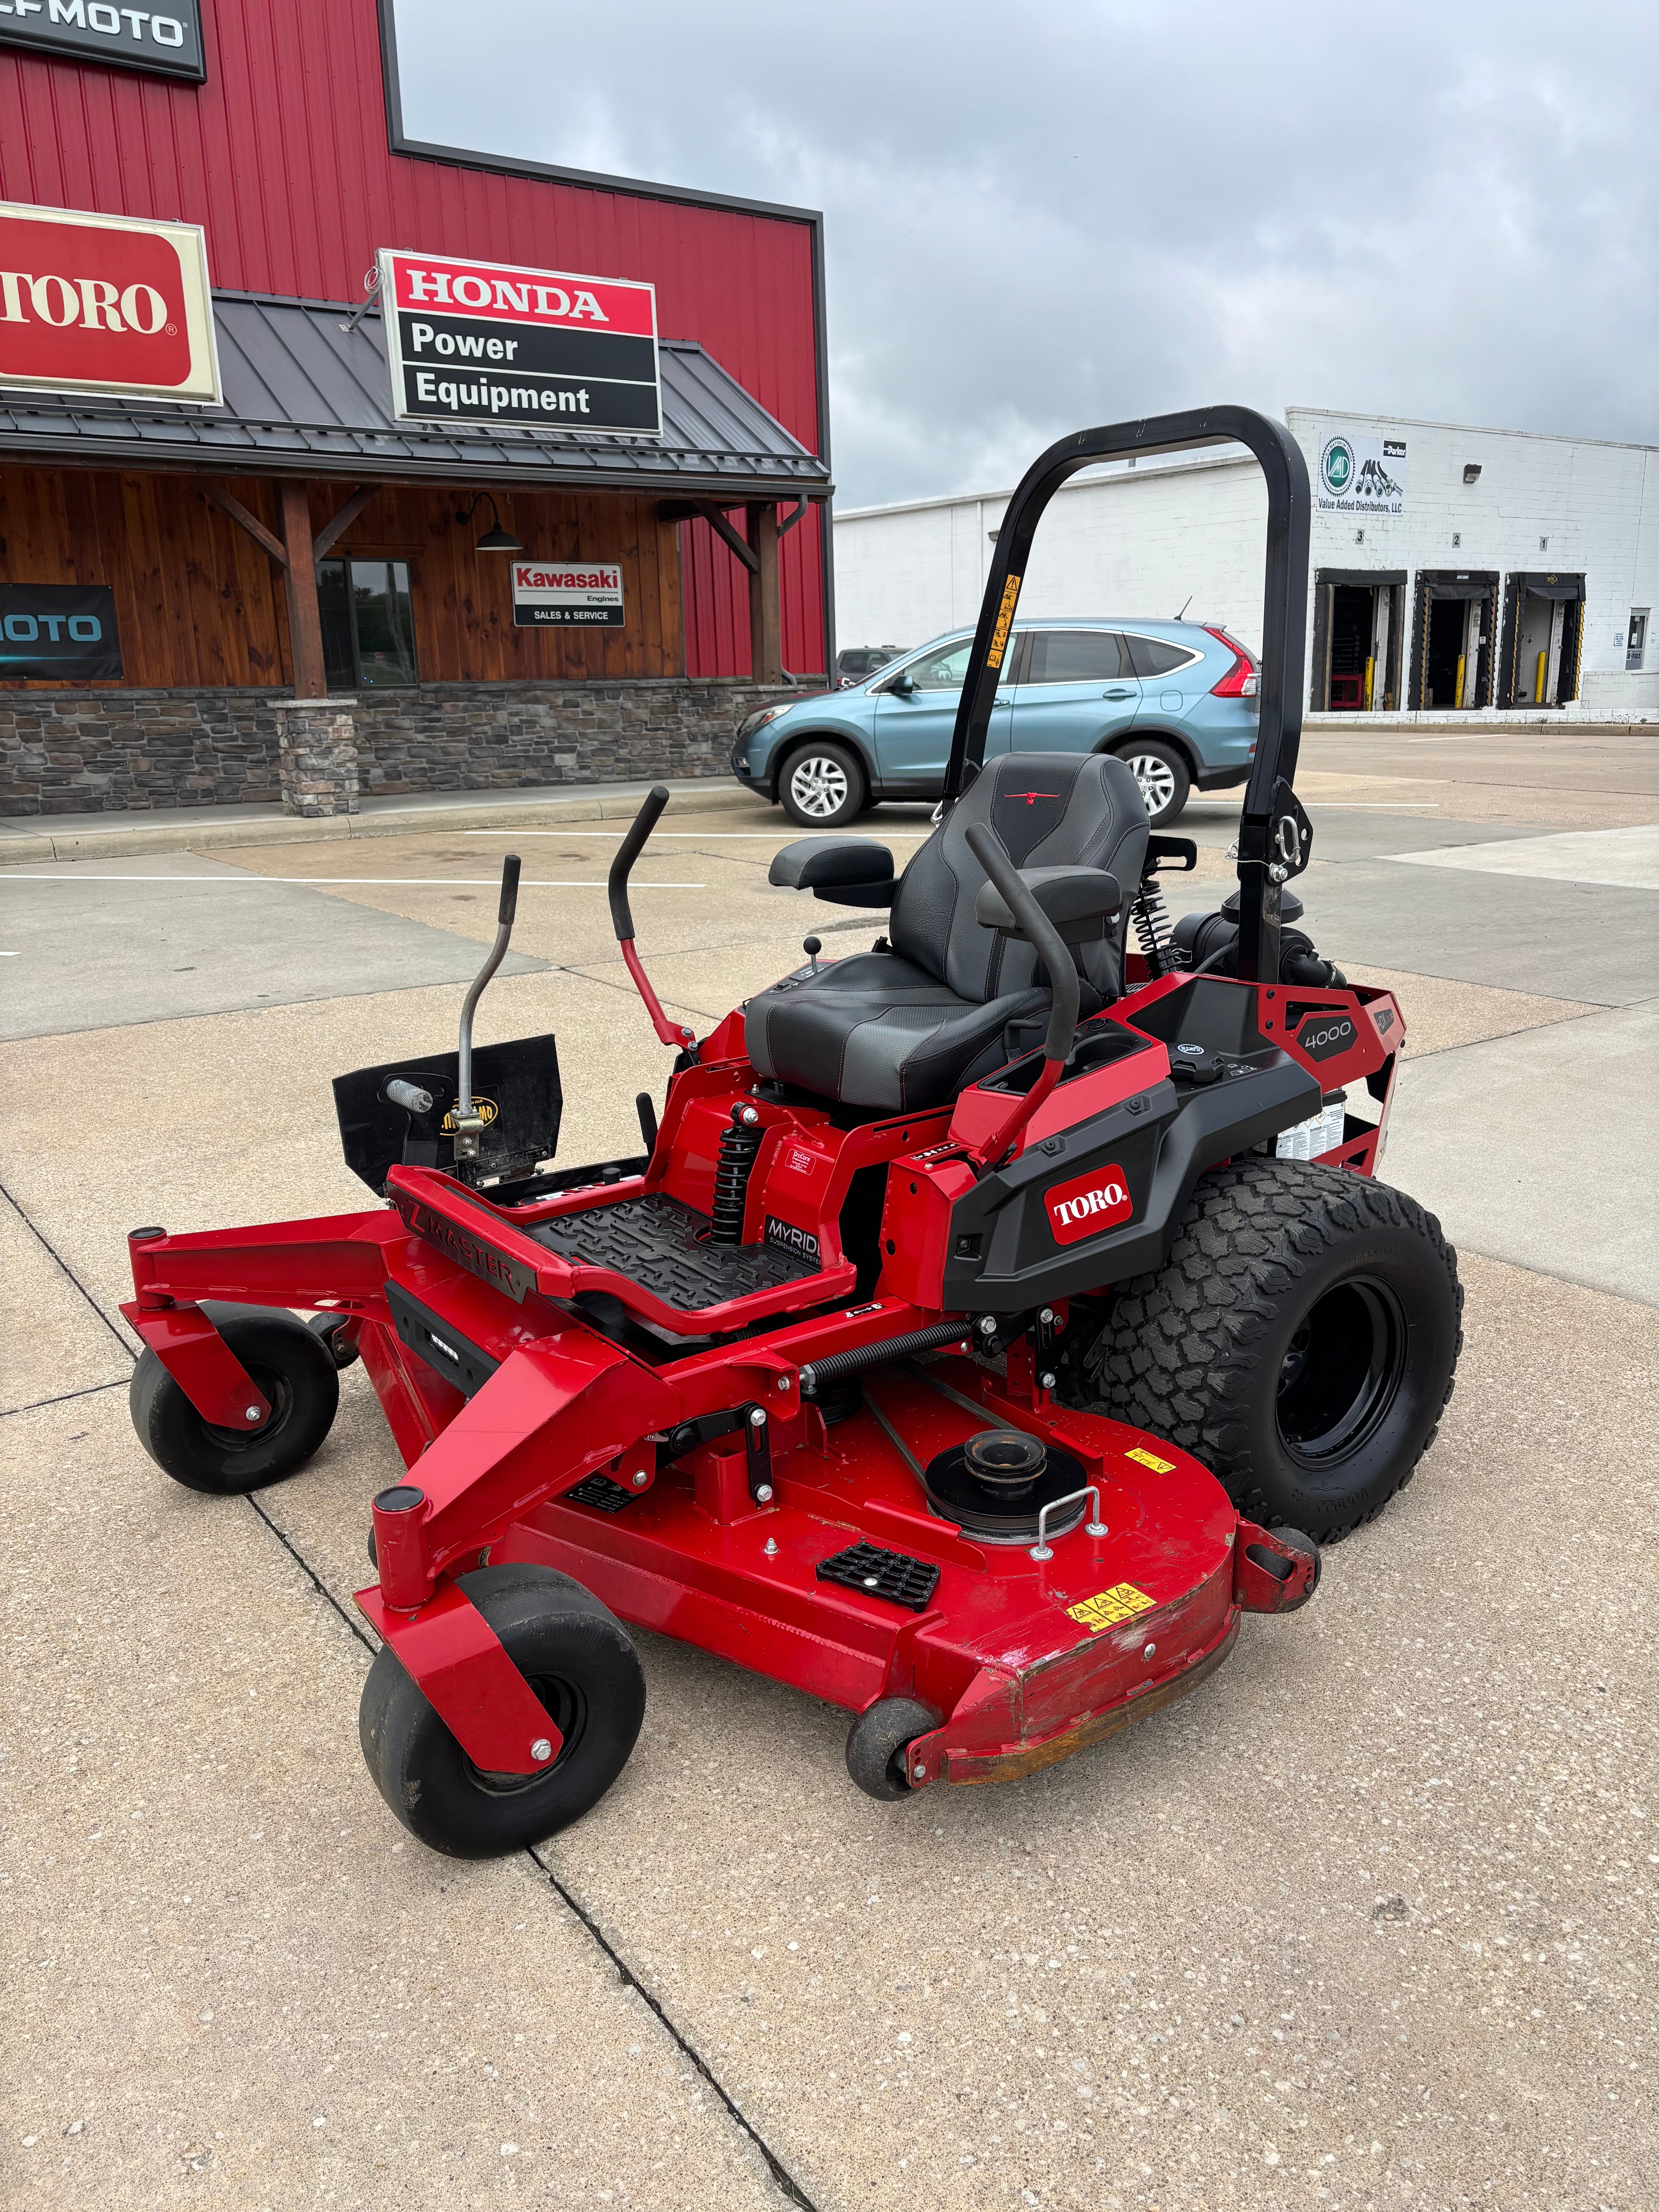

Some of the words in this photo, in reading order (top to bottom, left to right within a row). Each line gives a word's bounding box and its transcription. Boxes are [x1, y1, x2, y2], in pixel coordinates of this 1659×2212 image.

[0, 271, 168, 334] TORO
[406, 269, 610, 322] HONDA
[411, 322, 518, 361] Power
[416, 371, 590, 414] Equipment
[1387, 445, 1406, 456] Parker
[1328, 455, 1350, 478] VAD
[1319, 498, 1335, 509] Value
[1336, 499, 1355, 510] Added
[1356, 500, 1390, 514] Distributors,
[1392, 503, 1402, 513] LLC
[1357, 531, 1363, 542] 3
[1454, 535, 1460, 545] 2
[1542, 538, 1546, 548] 1
[516, 567, 618, 589] Kawasaki
[534, 611, 562, 620] SALES
[564, 611, 570, 620] &
[573, 611, 608, 620] SERVICE
[0, 615, 102, 641] OTO
[1305, 1022, 1351, 1048] 4000
[1053, 1183, 1123, 1226] TORO
[406, 1199, 425, 1233] Z
[428, 1216, 516, 1295] MASTER
[769, 1237, 801, 1256] SUSPENSION
